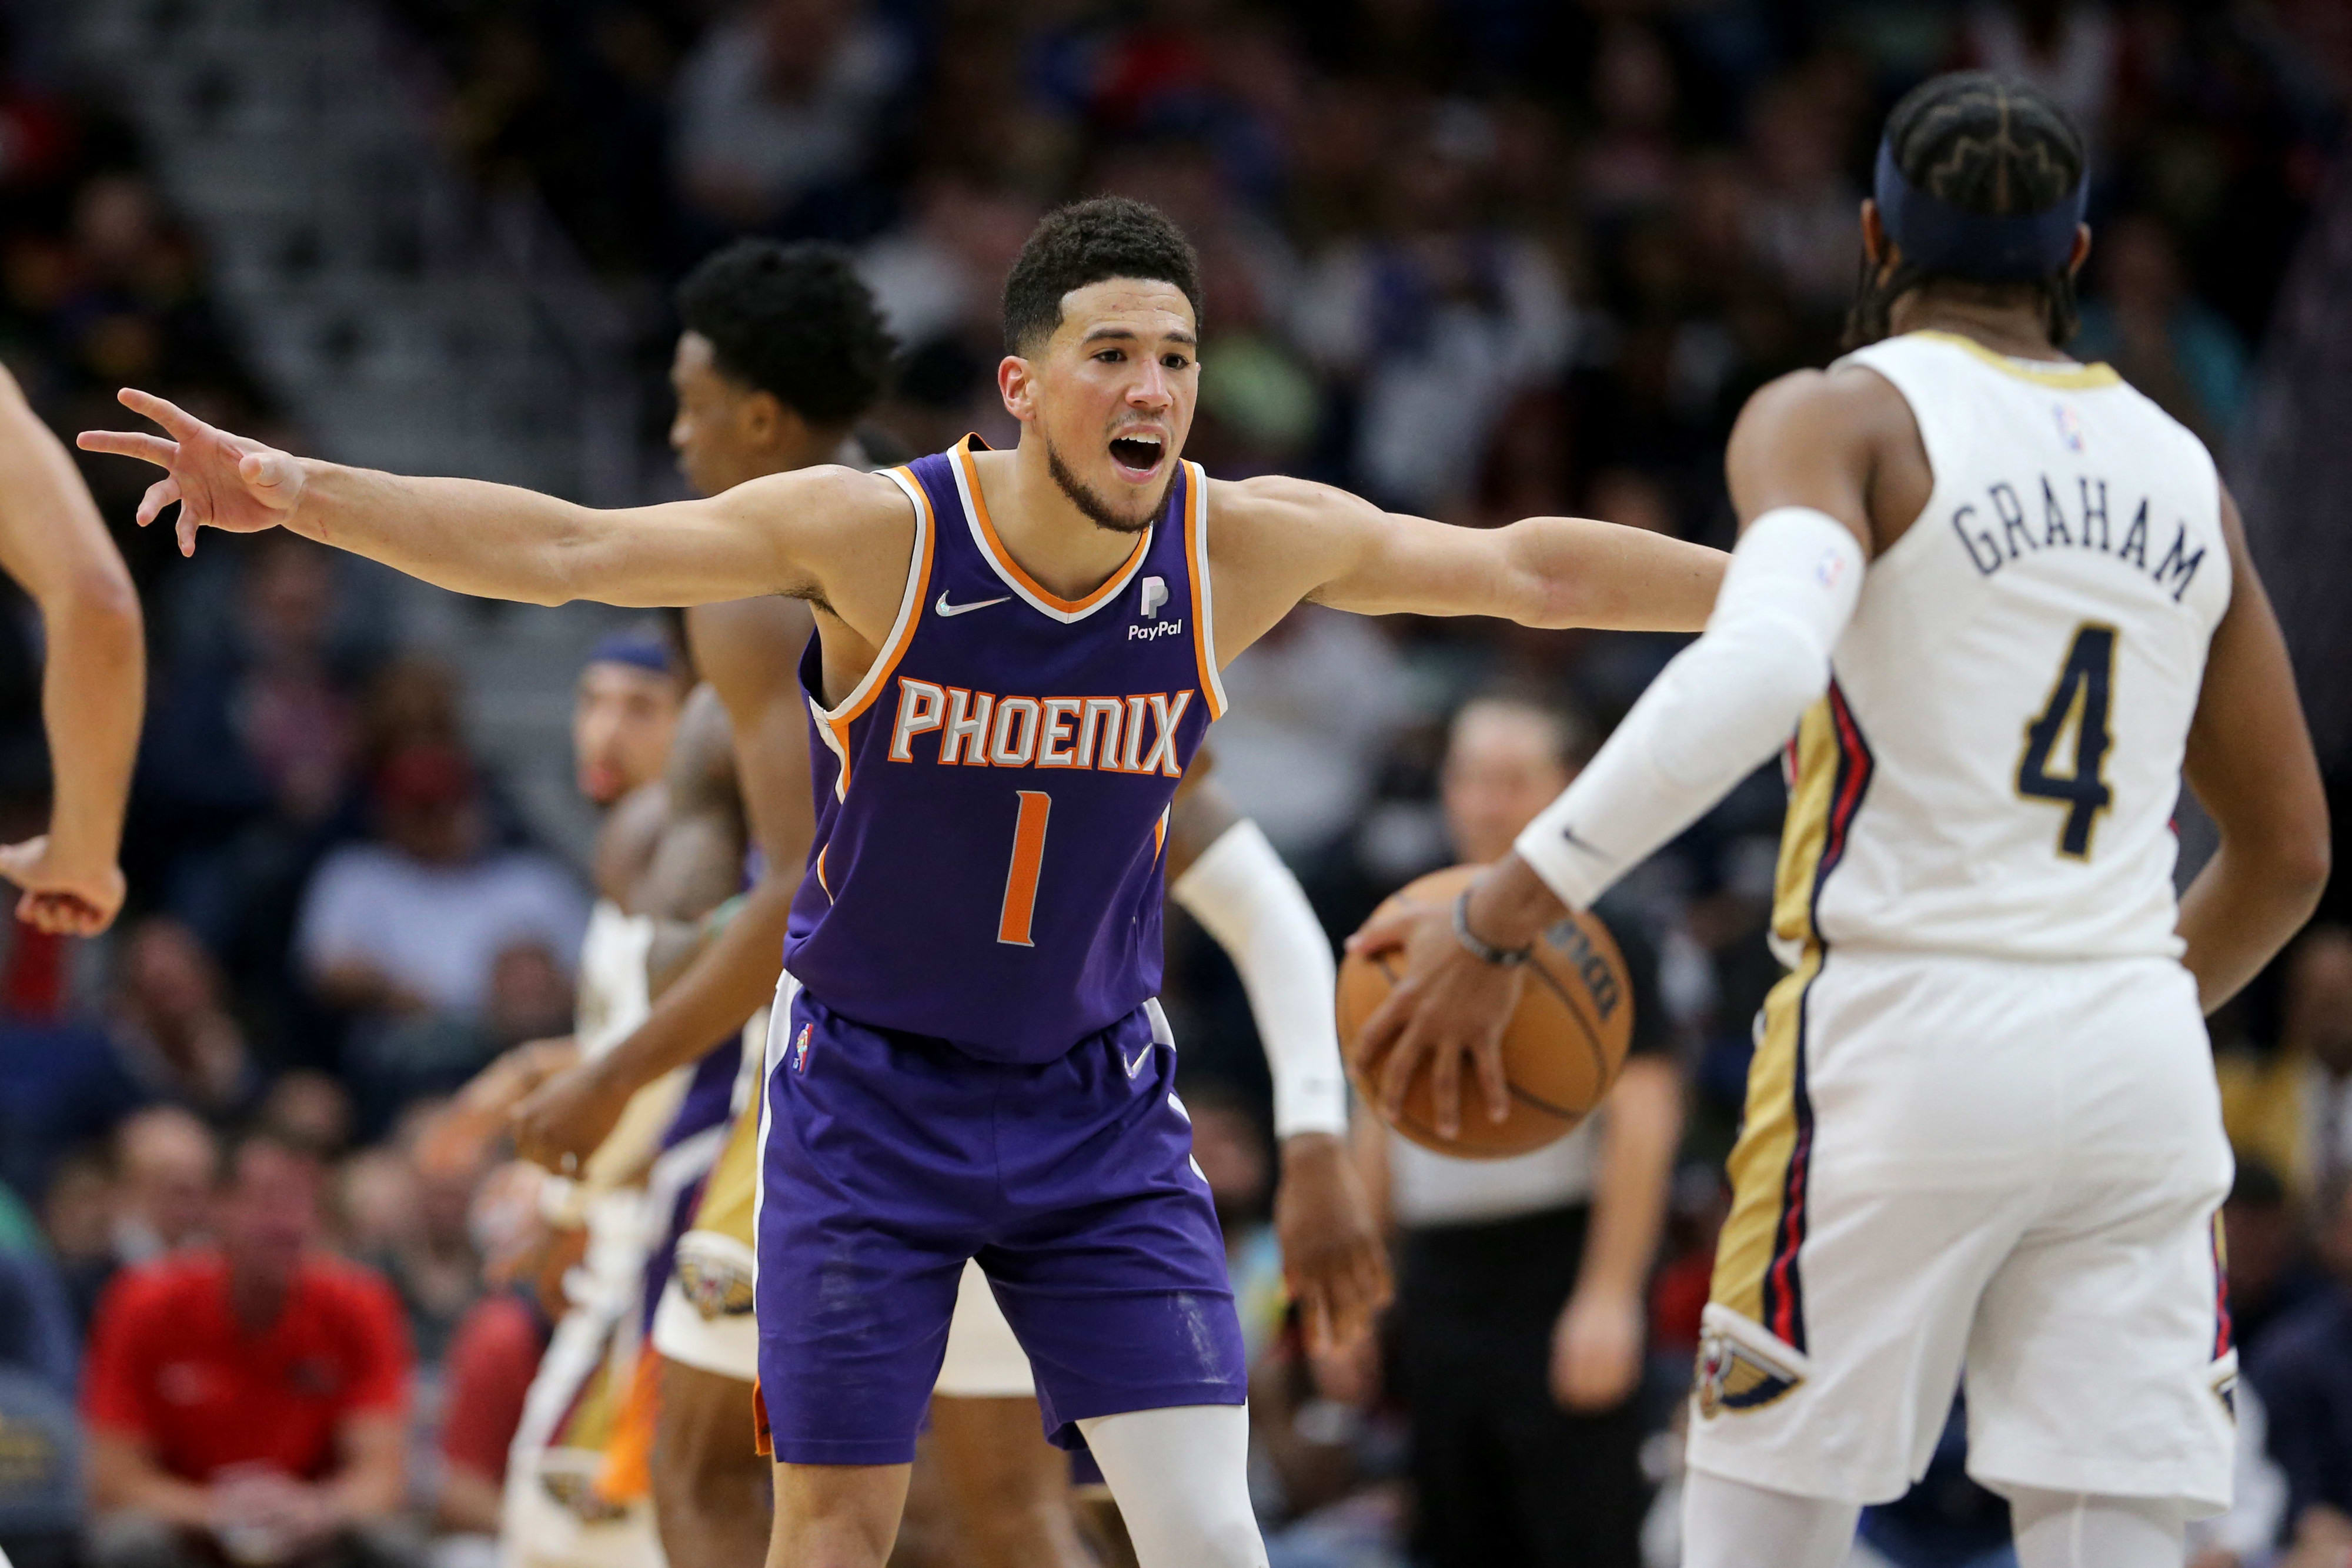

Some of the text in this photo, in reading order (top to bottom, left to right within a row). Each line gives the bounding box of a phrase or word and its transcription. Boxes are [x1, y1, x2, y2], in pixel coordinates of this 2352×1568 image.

[1953, 474, 2205, 602] GRAHAM
[1128, 619, 1182, 641] PayPal
[888, 676, 1195, 778] PHOENIX
[2014, 621, 2119, 863] 4
[997, 790, 1051, 947] 1
